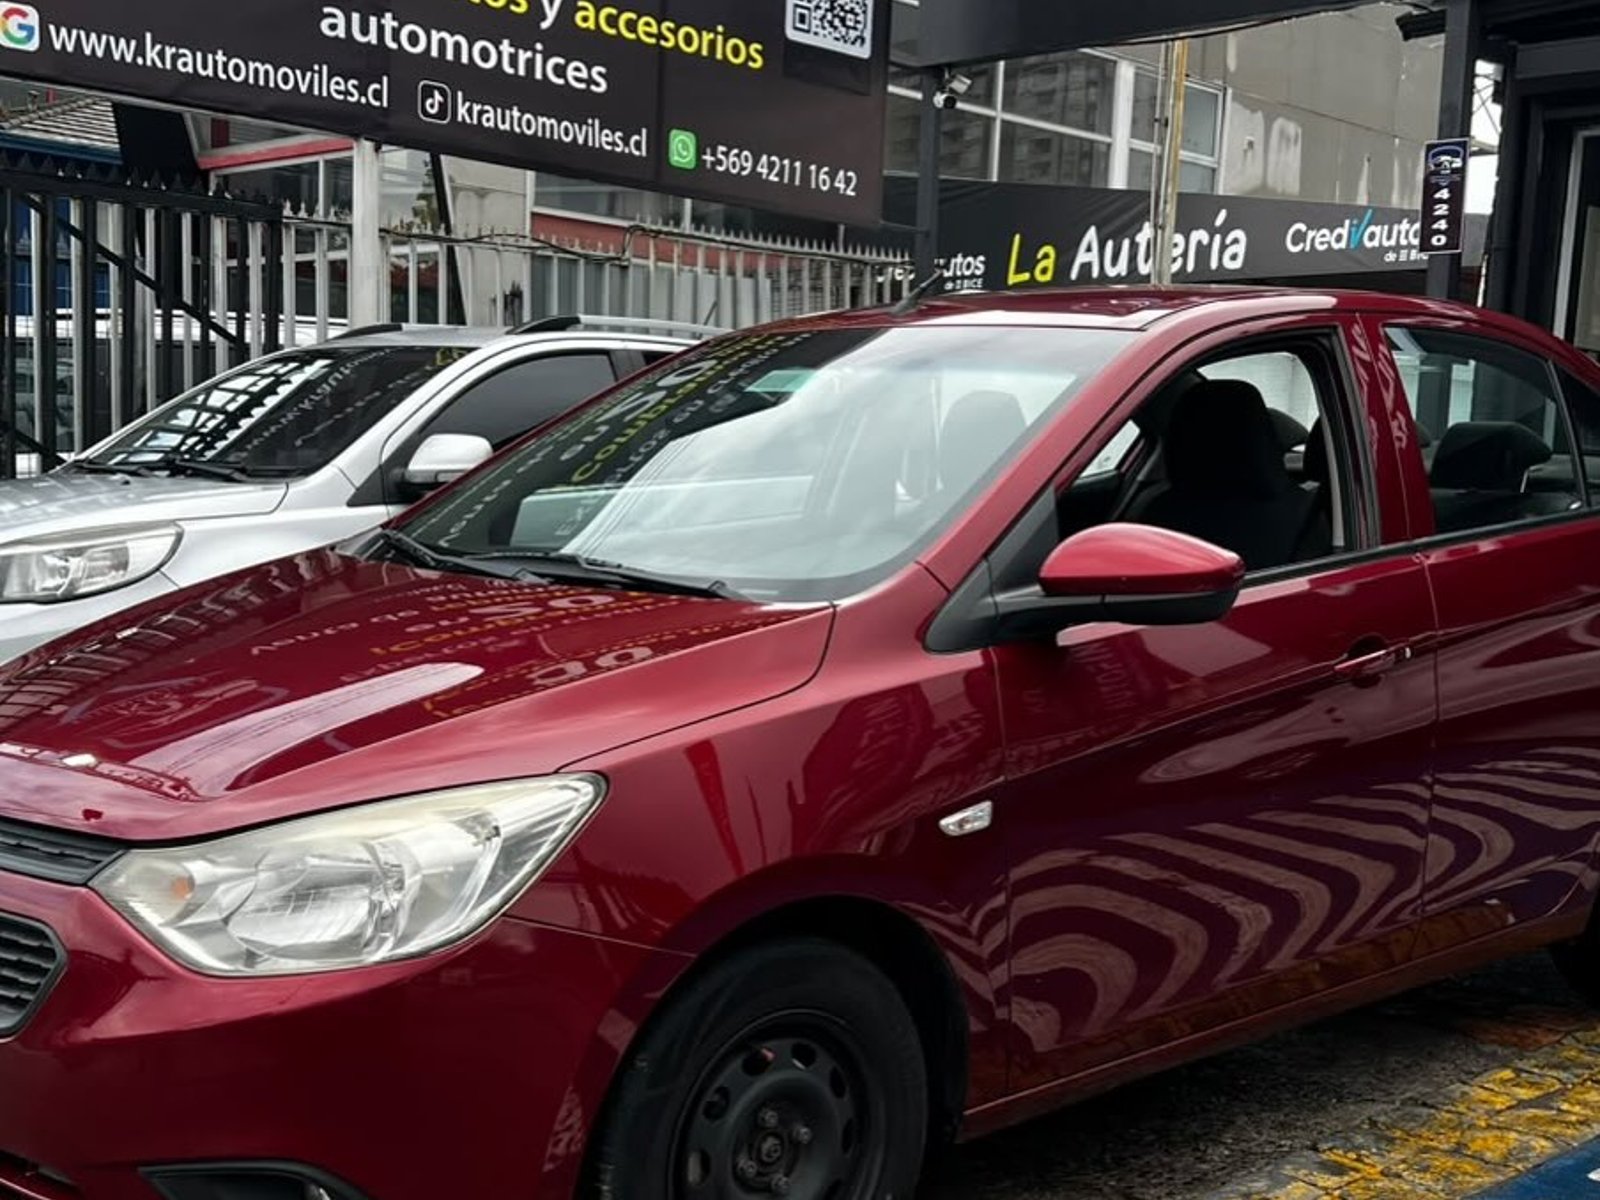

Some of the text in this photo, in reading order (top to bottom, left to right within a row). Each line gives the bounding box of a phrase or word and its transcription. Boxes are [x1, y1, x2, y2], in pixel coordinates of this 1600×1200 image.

[49, 24, 389, 108] www.krautomoviles.cl
[320, 6, 608, 93] automotrices
[540, 0, 764, 69] y accesorios
[457, 91, 647, 157] krautomoviles.cl
[701, 146, 858, 196] +569 4211 16 42
[1007, 208, 1247, 286] La Autería
[1430, 187, 1450, 246] 4240
